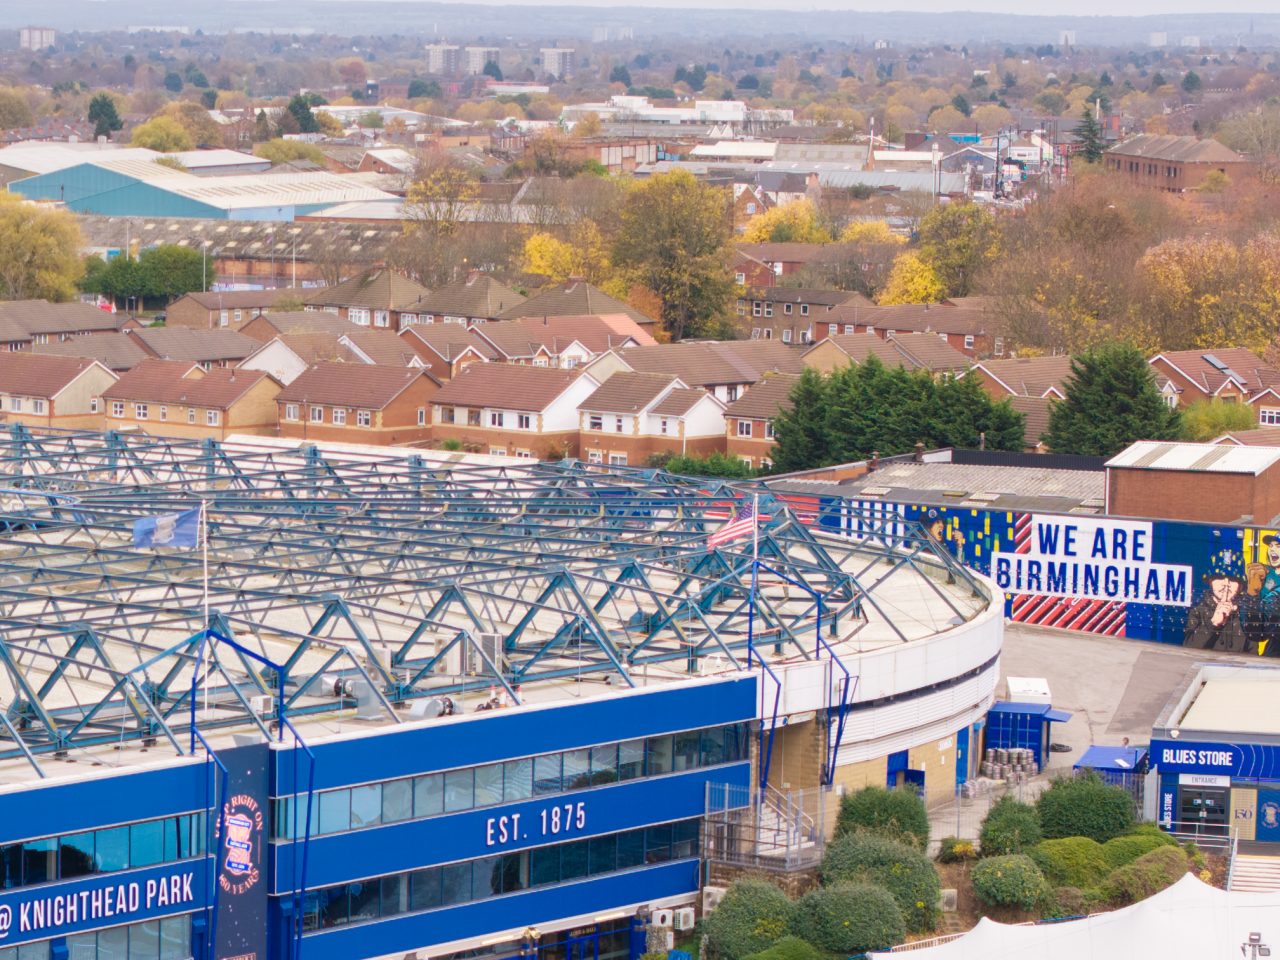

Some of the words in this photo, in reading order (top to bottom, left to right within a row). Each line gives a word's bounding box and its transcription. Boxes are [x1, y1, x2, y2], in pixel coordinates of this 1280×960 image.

[1038, 523, 1078, 556] WE
[1091, 527, 1146, 562] ARE
[996, 557, 1187, 603] BIRMINGHAM
[1162, 749, 1196, 764] BLUES
[1198, 750, 1233, 766] STORE
[1191, 776, 1218, 785] ENTRANCE
[231, 794, 259, 812] RIGHT
[486, 813, 527, 846] EST.
[540, 802, 585, 835] 1875
[20, 882, 139, 932] KNIGHTHEAD
[146, 872, 194, 909] PARK
